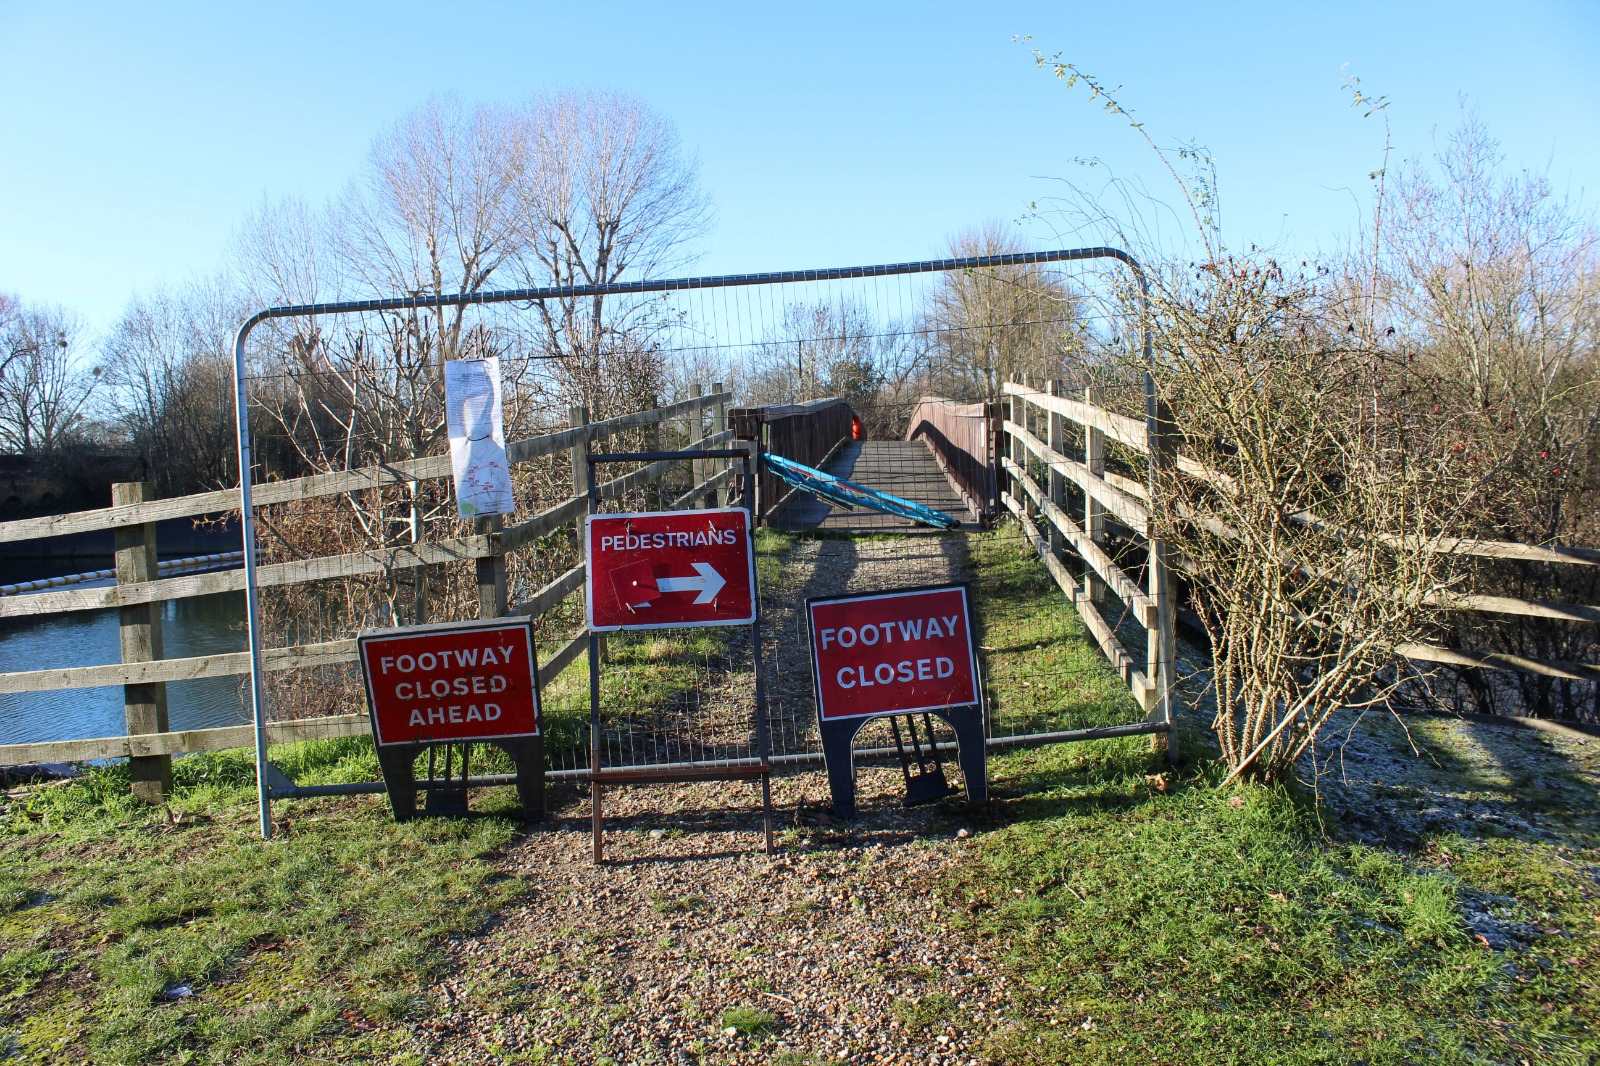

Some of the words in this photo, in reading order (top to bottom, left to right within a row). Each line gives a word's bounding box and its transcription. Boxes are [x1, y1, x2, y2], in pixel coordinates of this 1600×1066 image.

[601, 529, 737, 551] PEDESTRIANS
[820, 615, 958, 650] FOOTWAY
[380, 645, 514, 675] FOOTWAY
[836, 656, 955, 689] CLOSED
[395, 675, 507, 700] CLOSED
[408, 703, 502, 727] AHEAD
